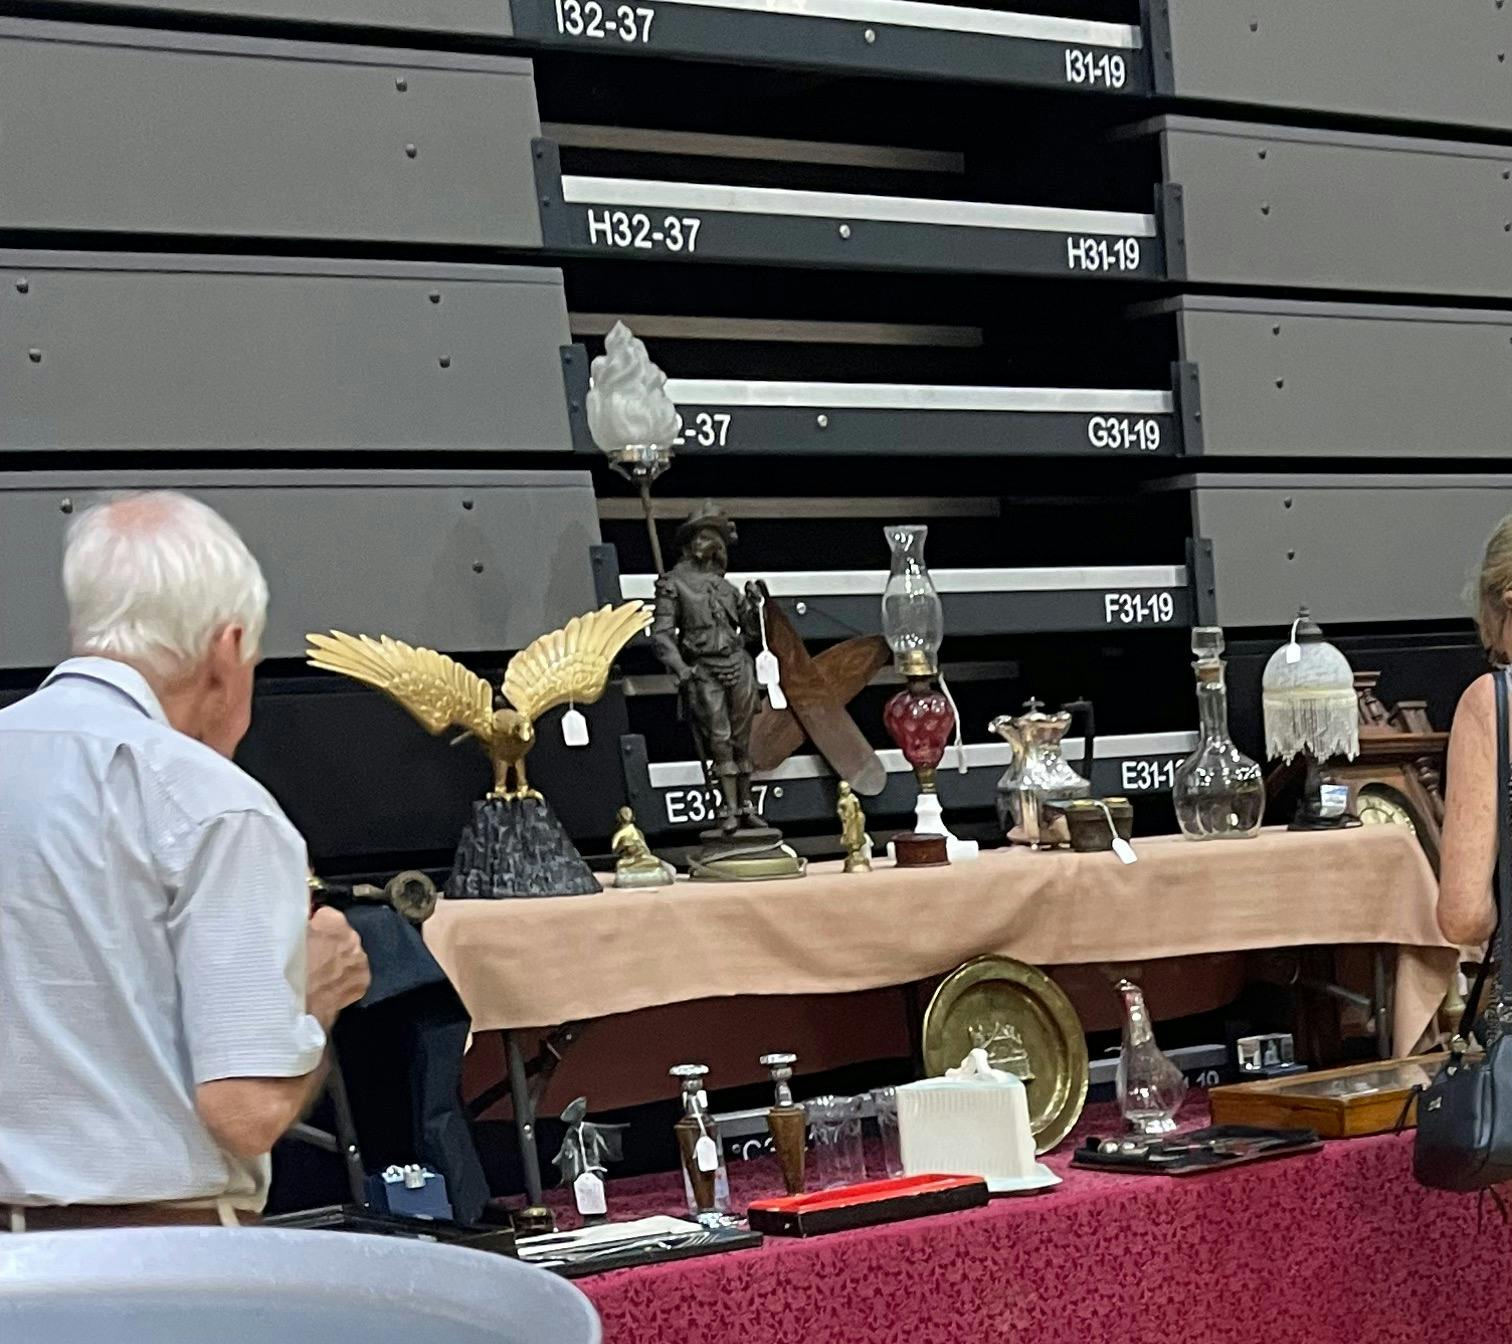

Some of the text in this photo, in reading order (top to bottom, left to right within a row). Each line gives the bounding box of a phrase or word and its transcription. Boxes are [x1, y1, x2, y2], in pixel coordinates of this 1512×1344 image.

[1065, 50, 1126, 88] I31-19
[587, 210, 701, 252] H32-37
[1067, 238, 1140, 271] H31-19
[1088, 416, 1160, 451] G31-19
[1104, 593, 1174, 624] F31-19
[1122, 759, 1185, 789] E31-1
